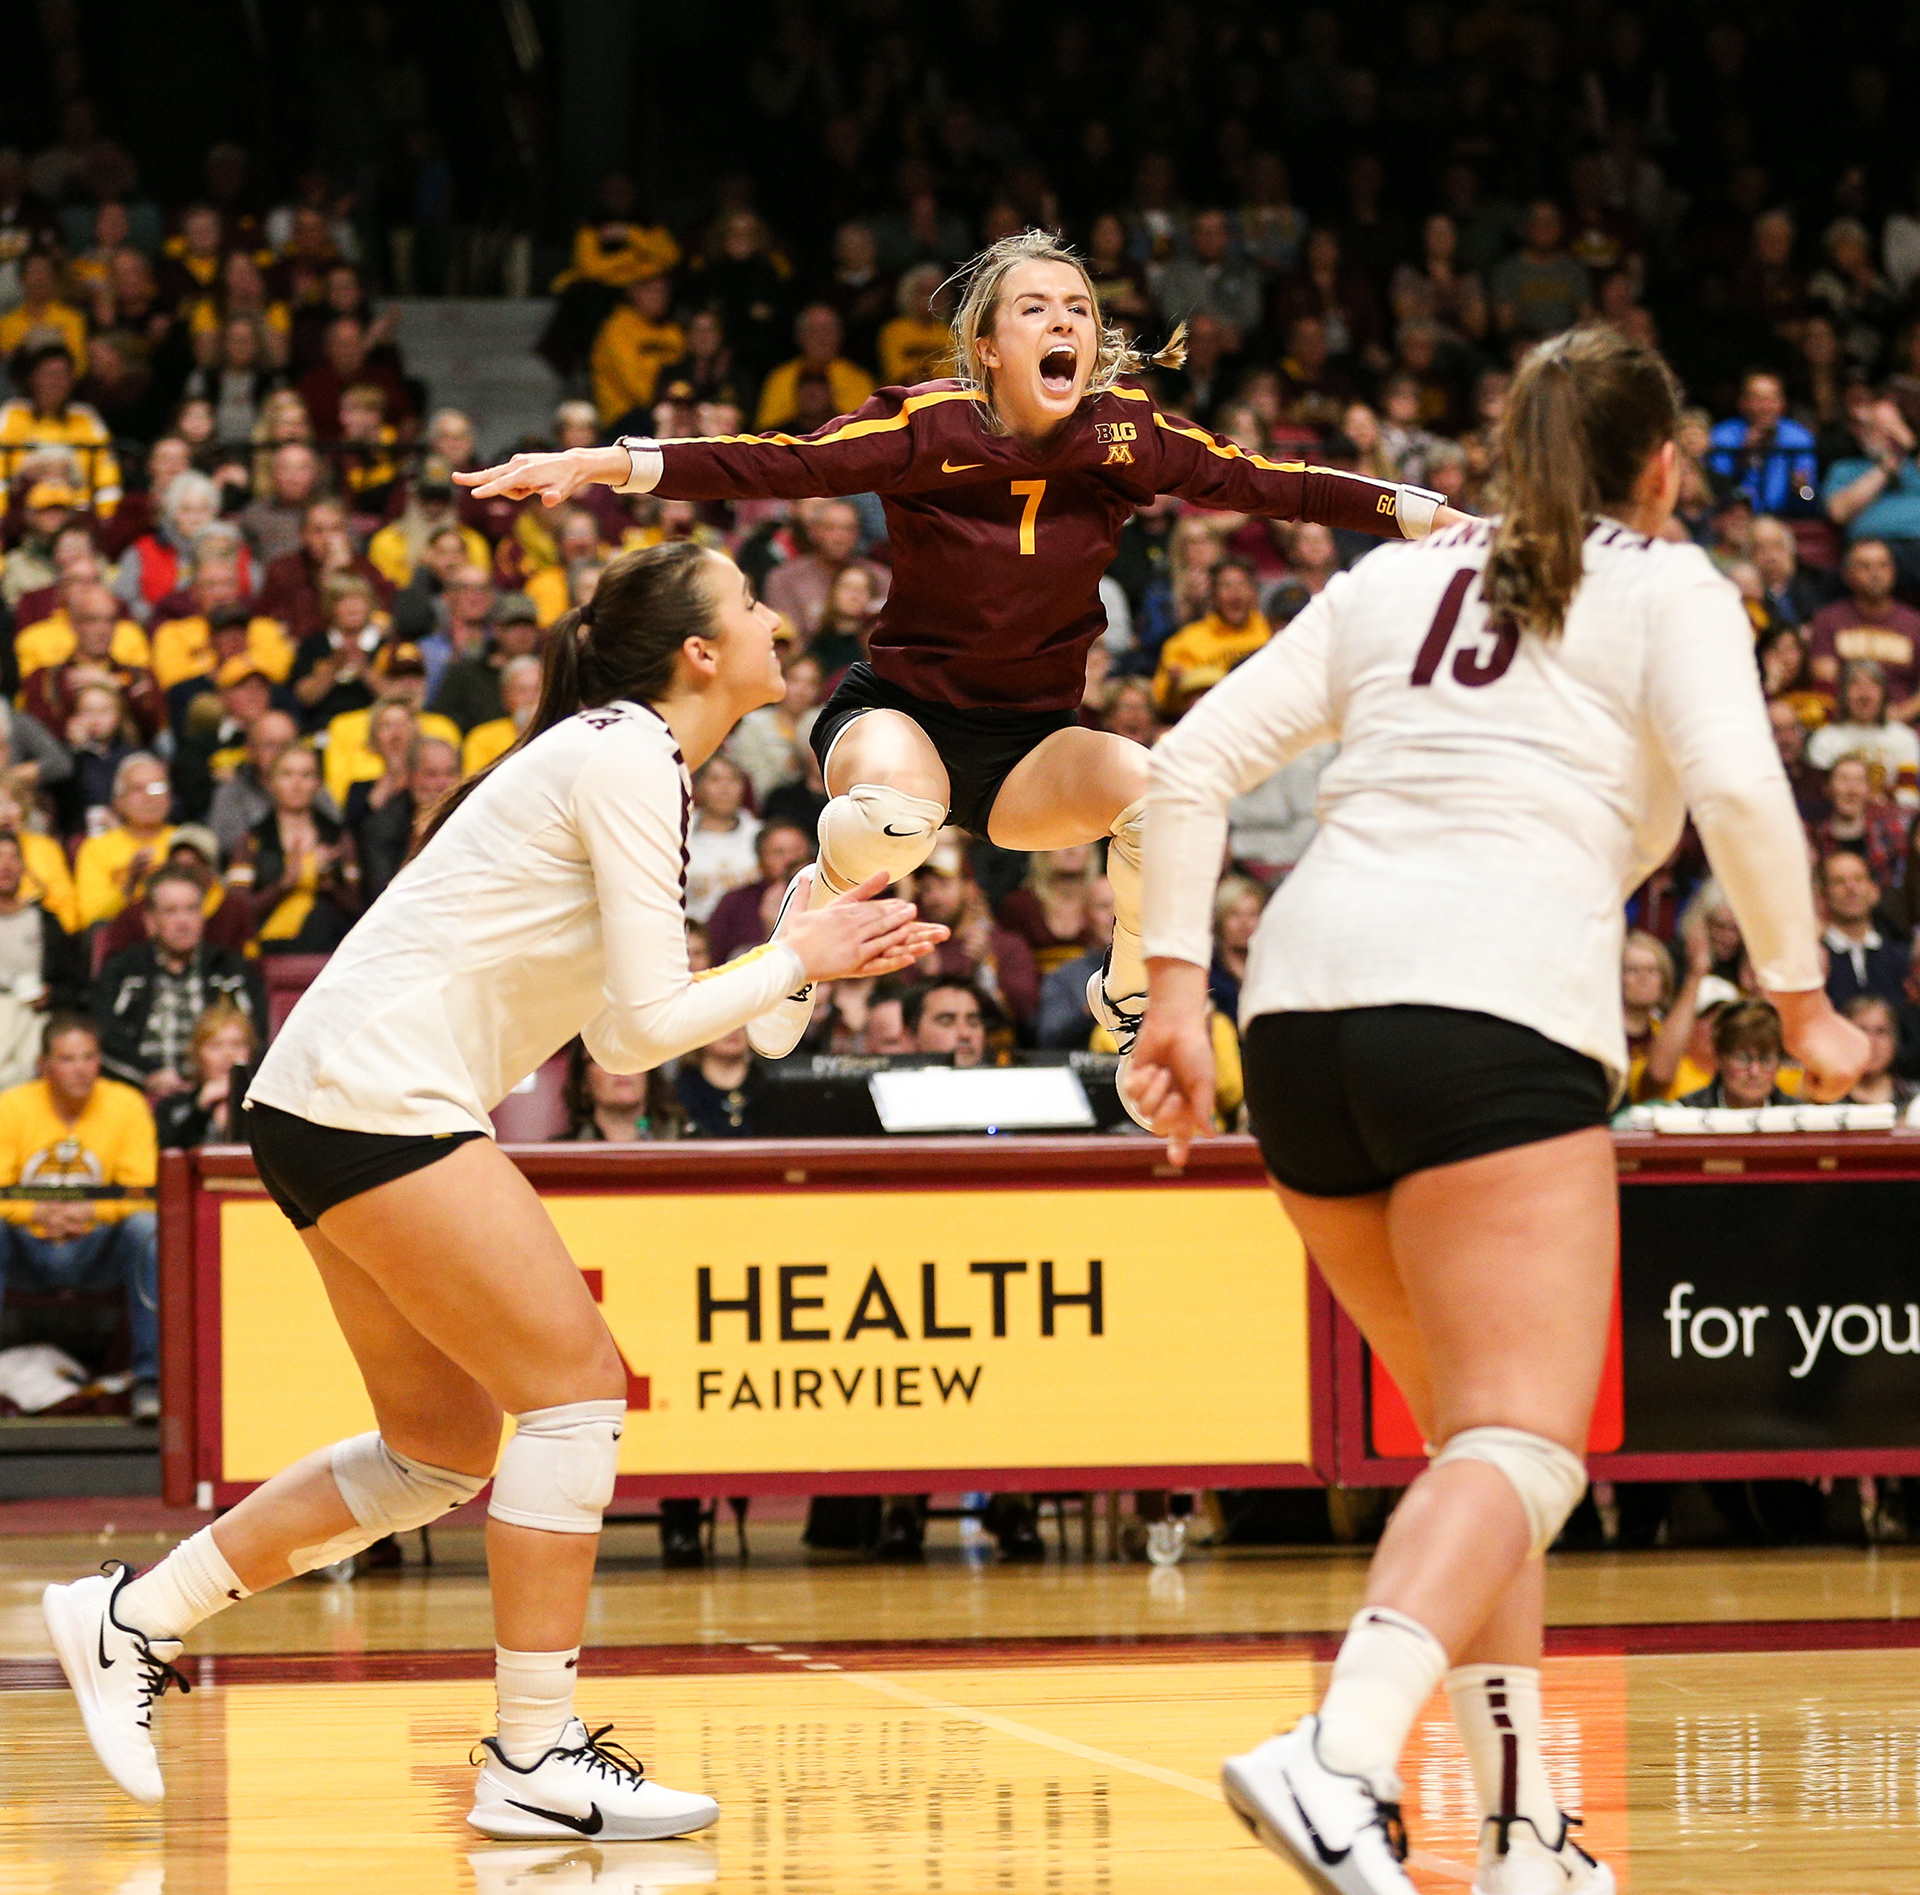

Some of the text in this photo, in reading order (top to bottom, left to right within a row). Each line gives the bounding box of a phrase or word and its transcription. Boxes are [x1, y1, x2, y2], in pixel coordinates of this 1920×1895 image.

[1010, 479, 1047, 556] 7
[697, 1260, 1104, 1343] HEALTH
[1662, 1281, 1920, 1379] for you
[697, 1365, 984, 1411] FAIRVIEW
